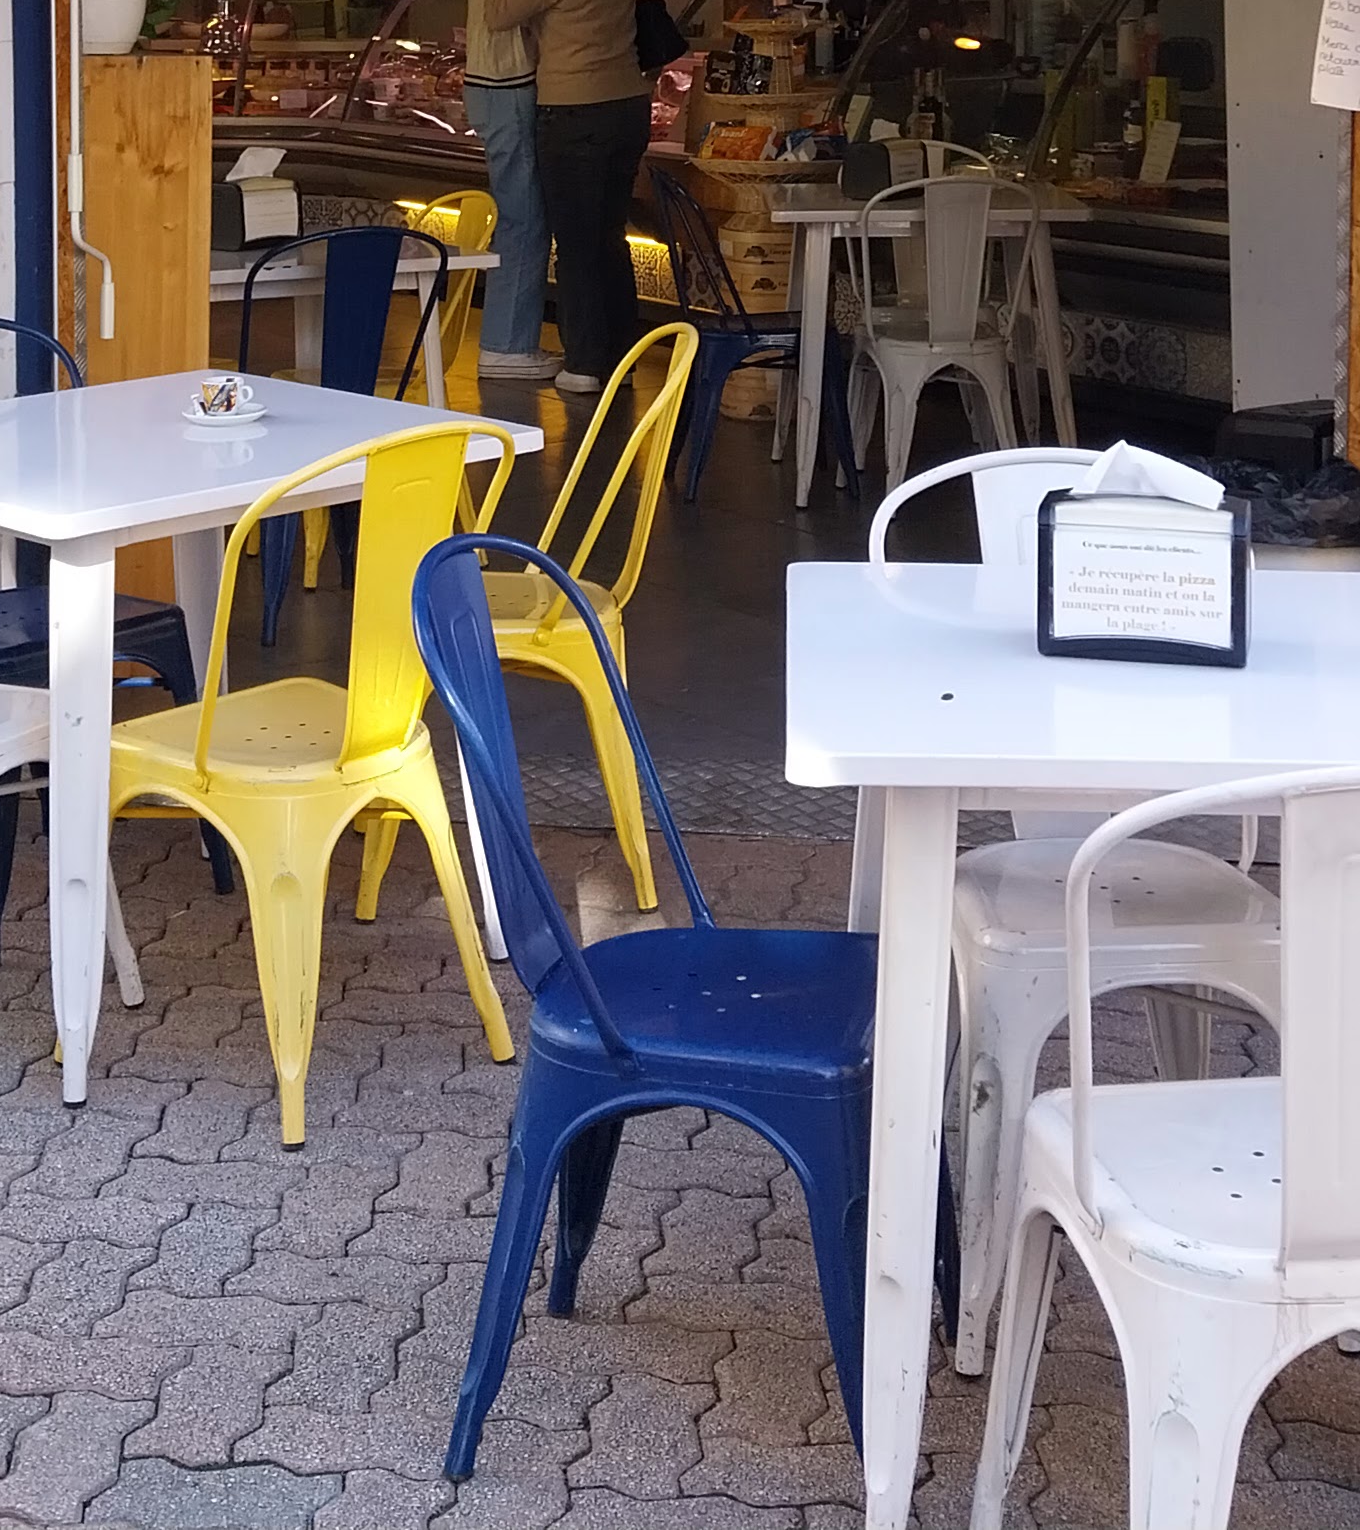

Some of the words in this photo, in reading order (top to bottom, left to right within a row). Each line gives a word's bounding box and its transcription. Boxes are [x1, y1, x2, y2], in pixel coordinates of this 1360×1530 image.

[1078, 566, 1095, 578] Je
[1099, 568, 1160, 584] récupère
[1163, 571, 1175, 583] la
[1178, 572, 1216, 587] pizza
[1068, 582, 1119, 596] demain
[1122, 587, 1162, 599] matin
[1165, 589, 1178, 600] et
[1182, 592, 1199, 601] on
[1203, 590, 1216, 602] la
[1061, 601, 1120, 612] mangera
[1123, 603, 1160, 615] entre
[1163, 606, 1196, 617] amis
[1200, 610, 1223, 620] sur
[1106, 616, 1119, 629] la
[1122, 617, 1158, 632] plage
